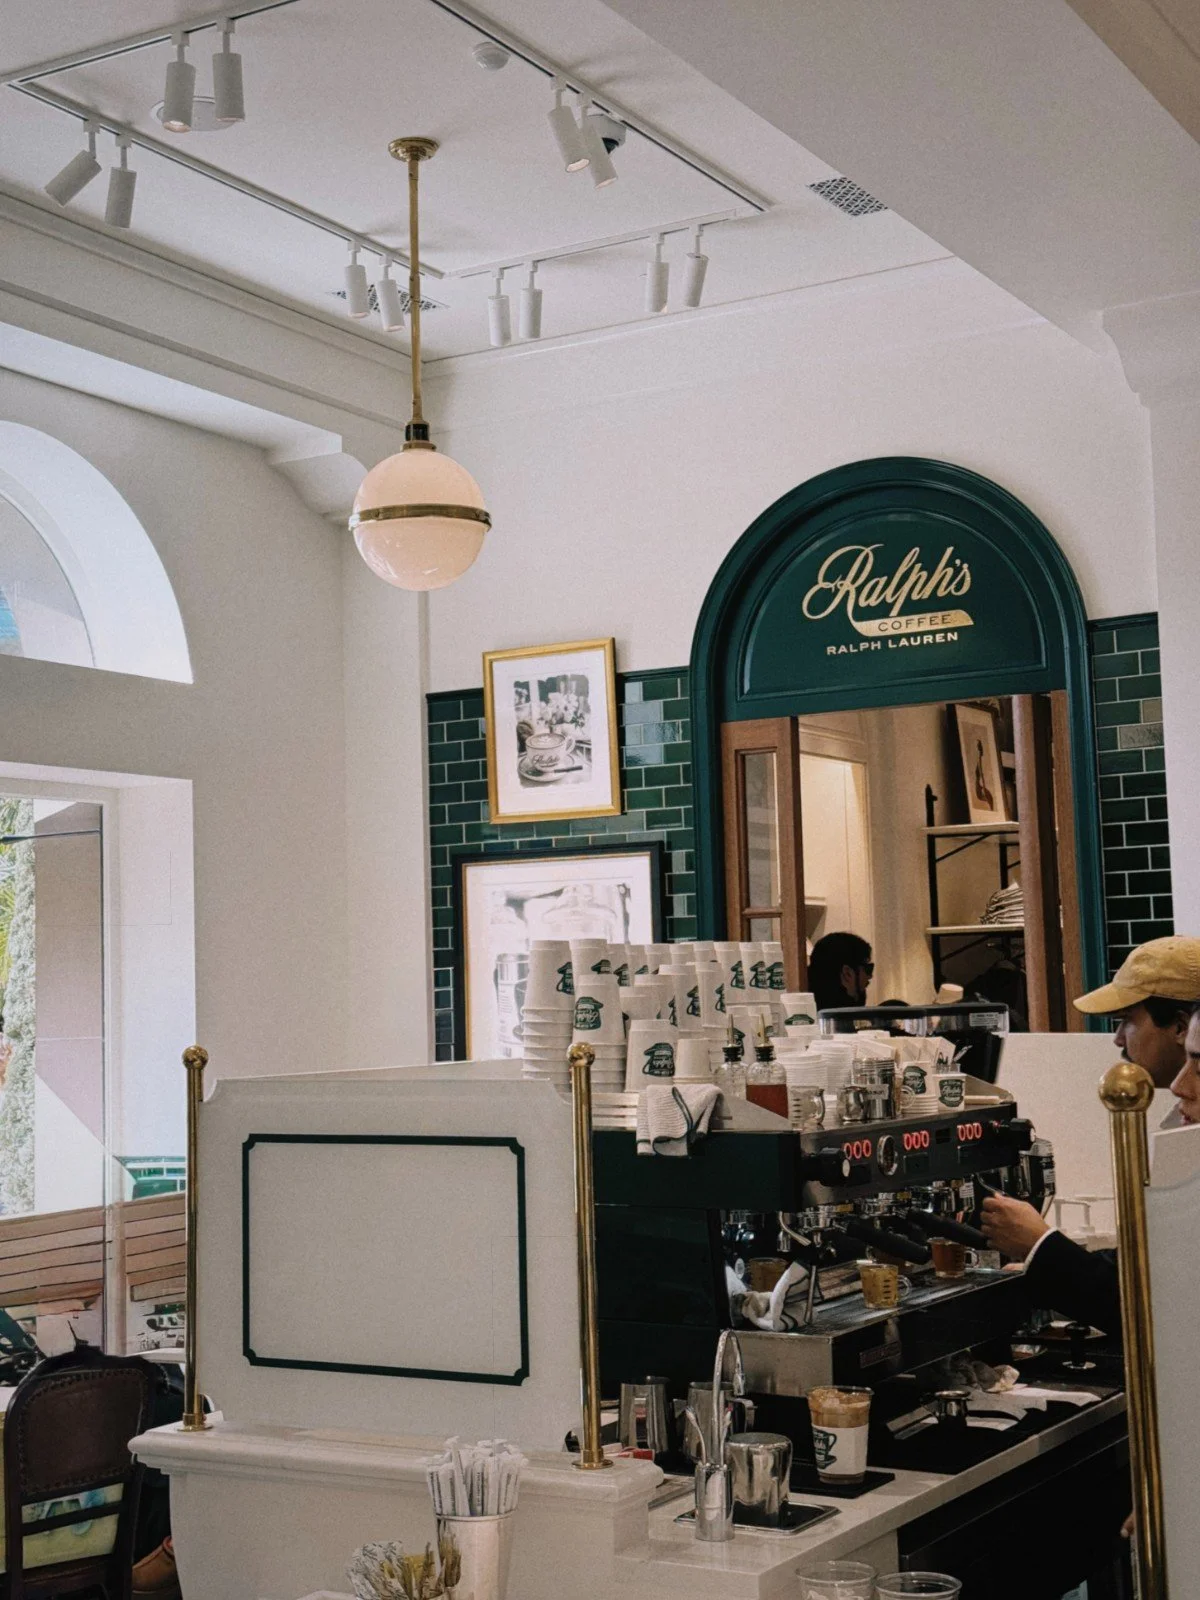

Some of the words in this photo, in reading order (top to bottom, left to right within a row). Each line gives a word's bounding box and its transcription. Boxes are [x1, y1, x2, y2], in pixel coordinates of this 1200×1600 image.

[802, 543, 972, 620] Ralph's
[878, 614, 952, 632] COFFEE
[826, 640, 882, 656] RALPH
[888, 631, 959, 649] LAUREN
